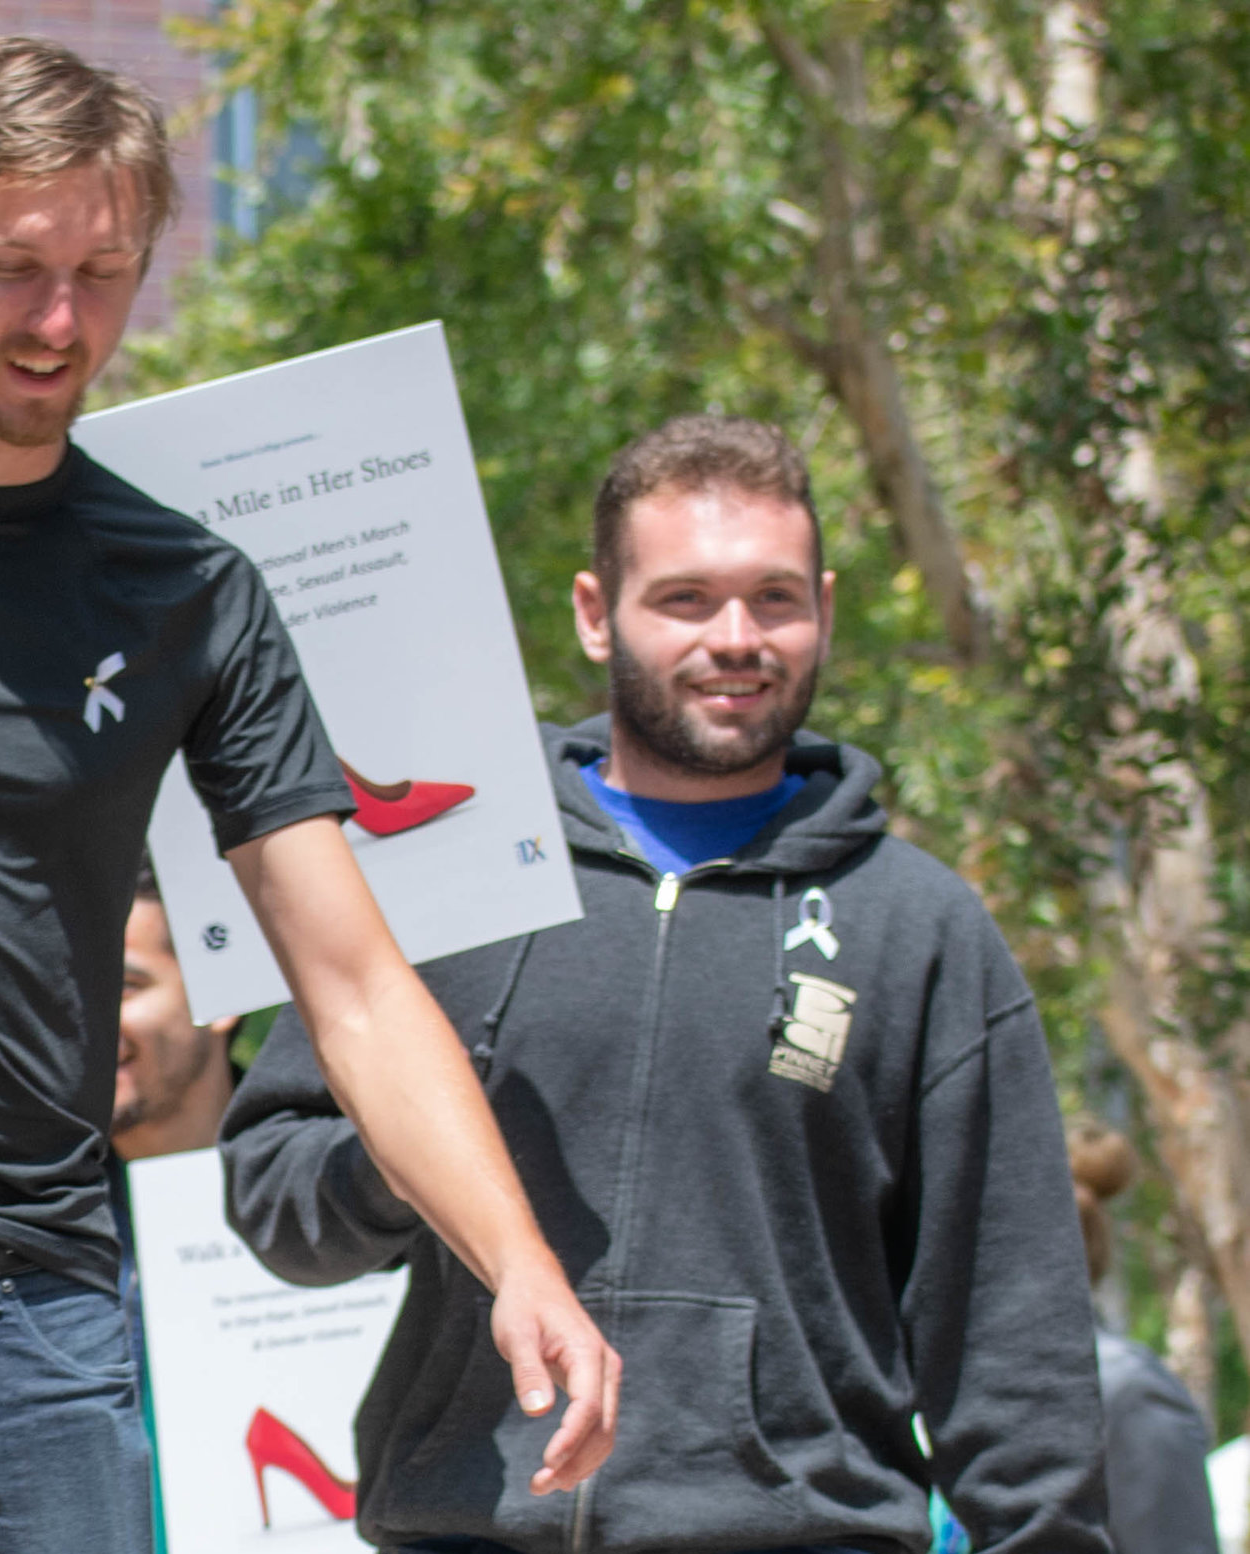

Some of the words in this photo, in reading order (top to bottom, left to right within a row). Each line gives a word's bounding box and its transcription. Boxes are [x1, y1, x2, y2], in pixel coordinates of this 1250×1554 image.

[196, 508, 210, 525] a
[214, 491, 273, 521] Mile
[279, 480, 303, 505] in
[307, 469, 355, 497] Her
[360, 449, 433, 484] Shoes
[311, 535, 357, 558] Men's
[360, 520, 410, 545] March
[296, 565, 345, 592] Sexual
[349, 550, 409, 577] Assault,
[313, 594, 378, 620] Violence
